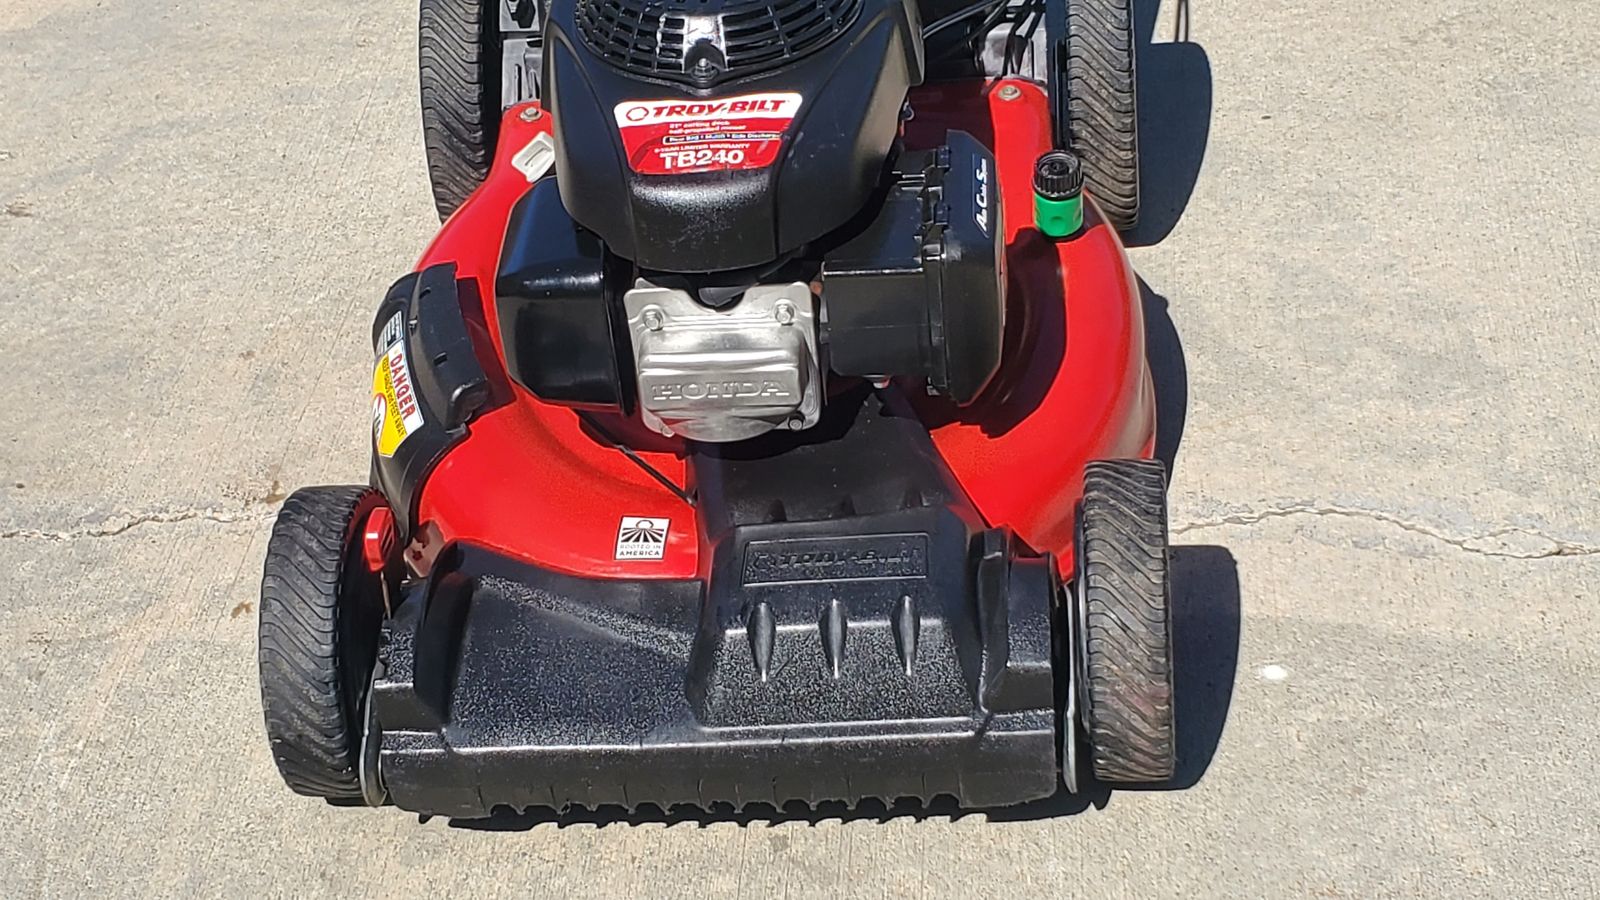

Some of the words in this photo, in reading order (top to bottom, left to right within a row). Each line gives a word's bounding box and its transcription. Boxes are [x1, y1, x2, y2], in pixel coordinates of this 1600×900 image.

[653, 99, 786, 117] TROY-BILT
[659, 149, 745, 169] TB240
[390, 353, 416, 421] DANGER
[651, 379, 790, 400] HONDA
